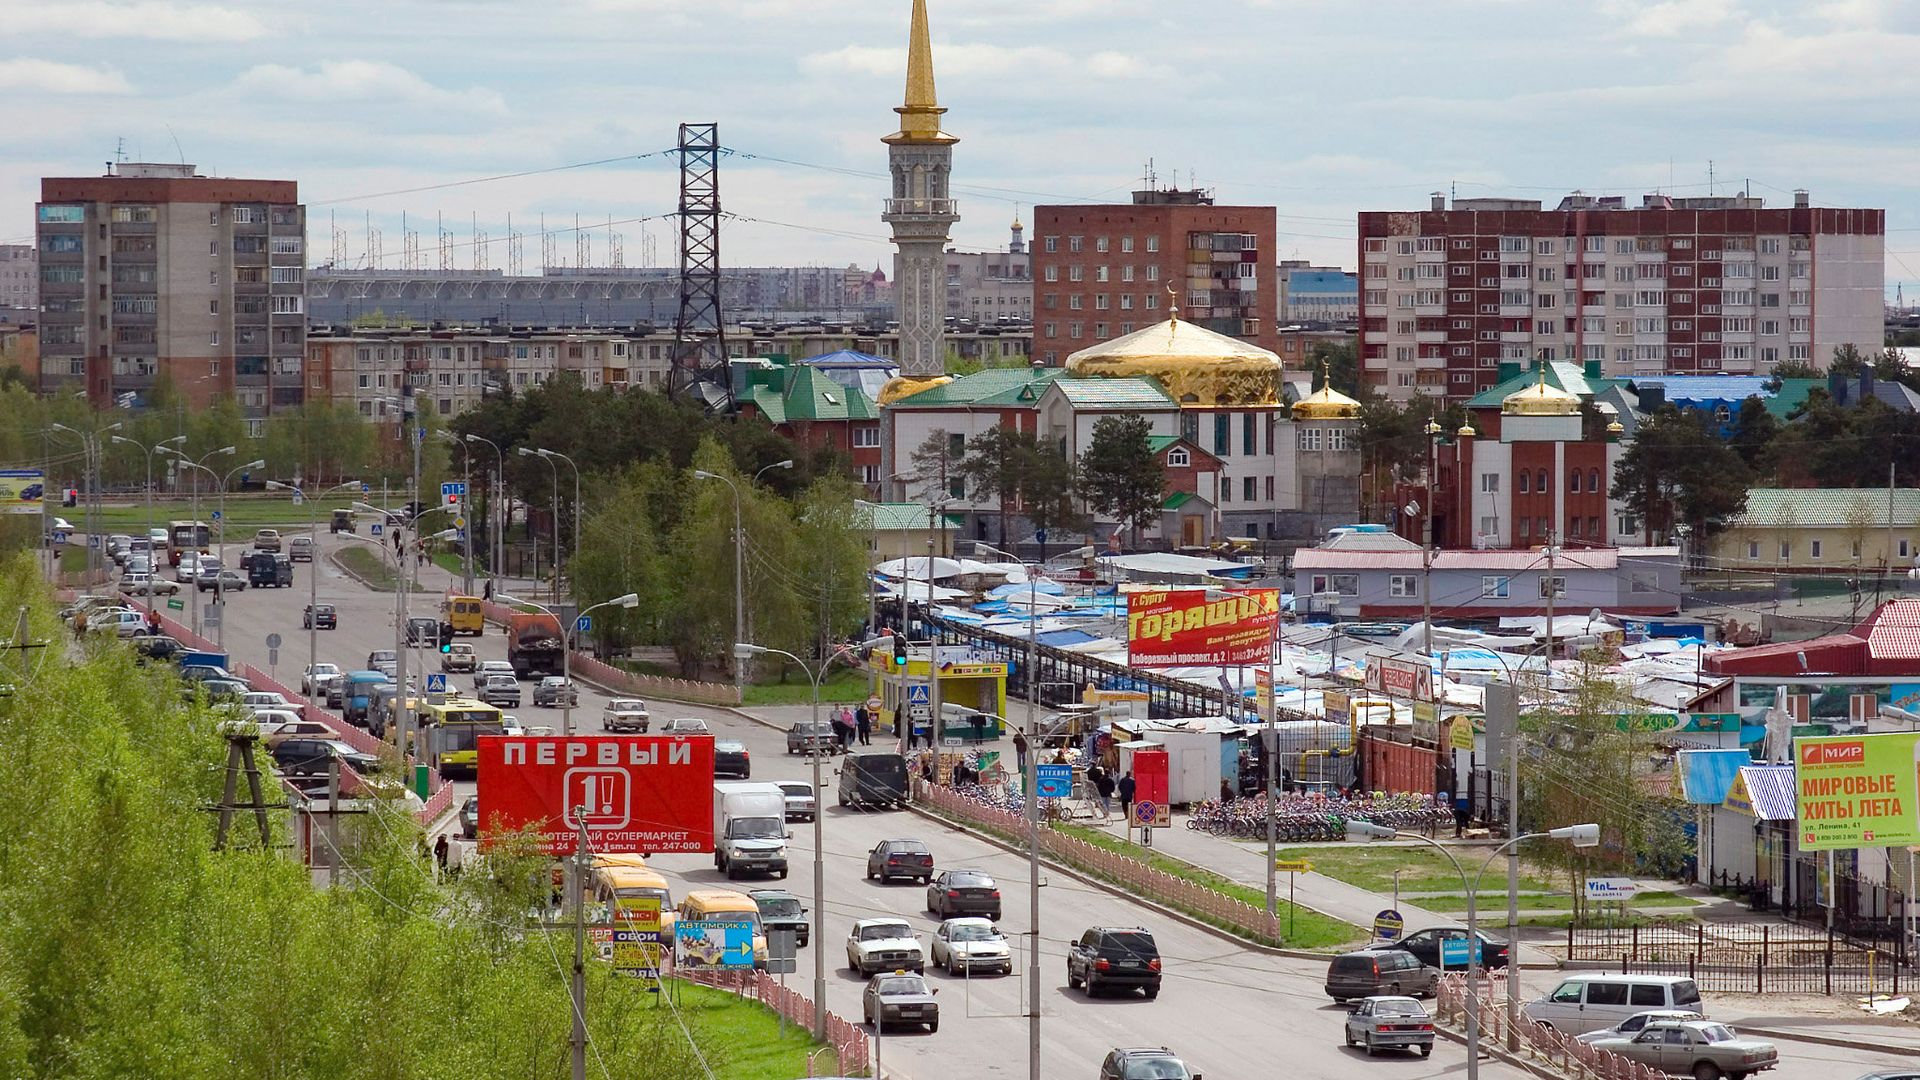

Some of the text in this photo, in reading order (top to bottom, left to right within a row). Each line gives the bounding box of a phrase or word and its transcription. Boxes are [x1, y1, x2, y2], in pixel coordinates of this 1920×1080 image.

[1139, 593, 1168, 605] Сургут
[1129, 590, 1280, 642] Горящих
[1146, 606, 1173, 615] магазин
[504, 735, 691, 765] ПЕРВЫЙ
[1825, 746, 1862, 758] МИР
[1803, 774, 1896, 797] МИРОВЫЕ
[1804, 798, 1903, 820] ХИТЫ ЛЕТА
[504, 831, 689, 841] КОПЬЮТЕРЫЙ СУПЕРМАРКЕТ
[556, 842, 569, 850] 24
[642, 842, 660, 850] тел.
[662, 842, 701, 850] 247-000
